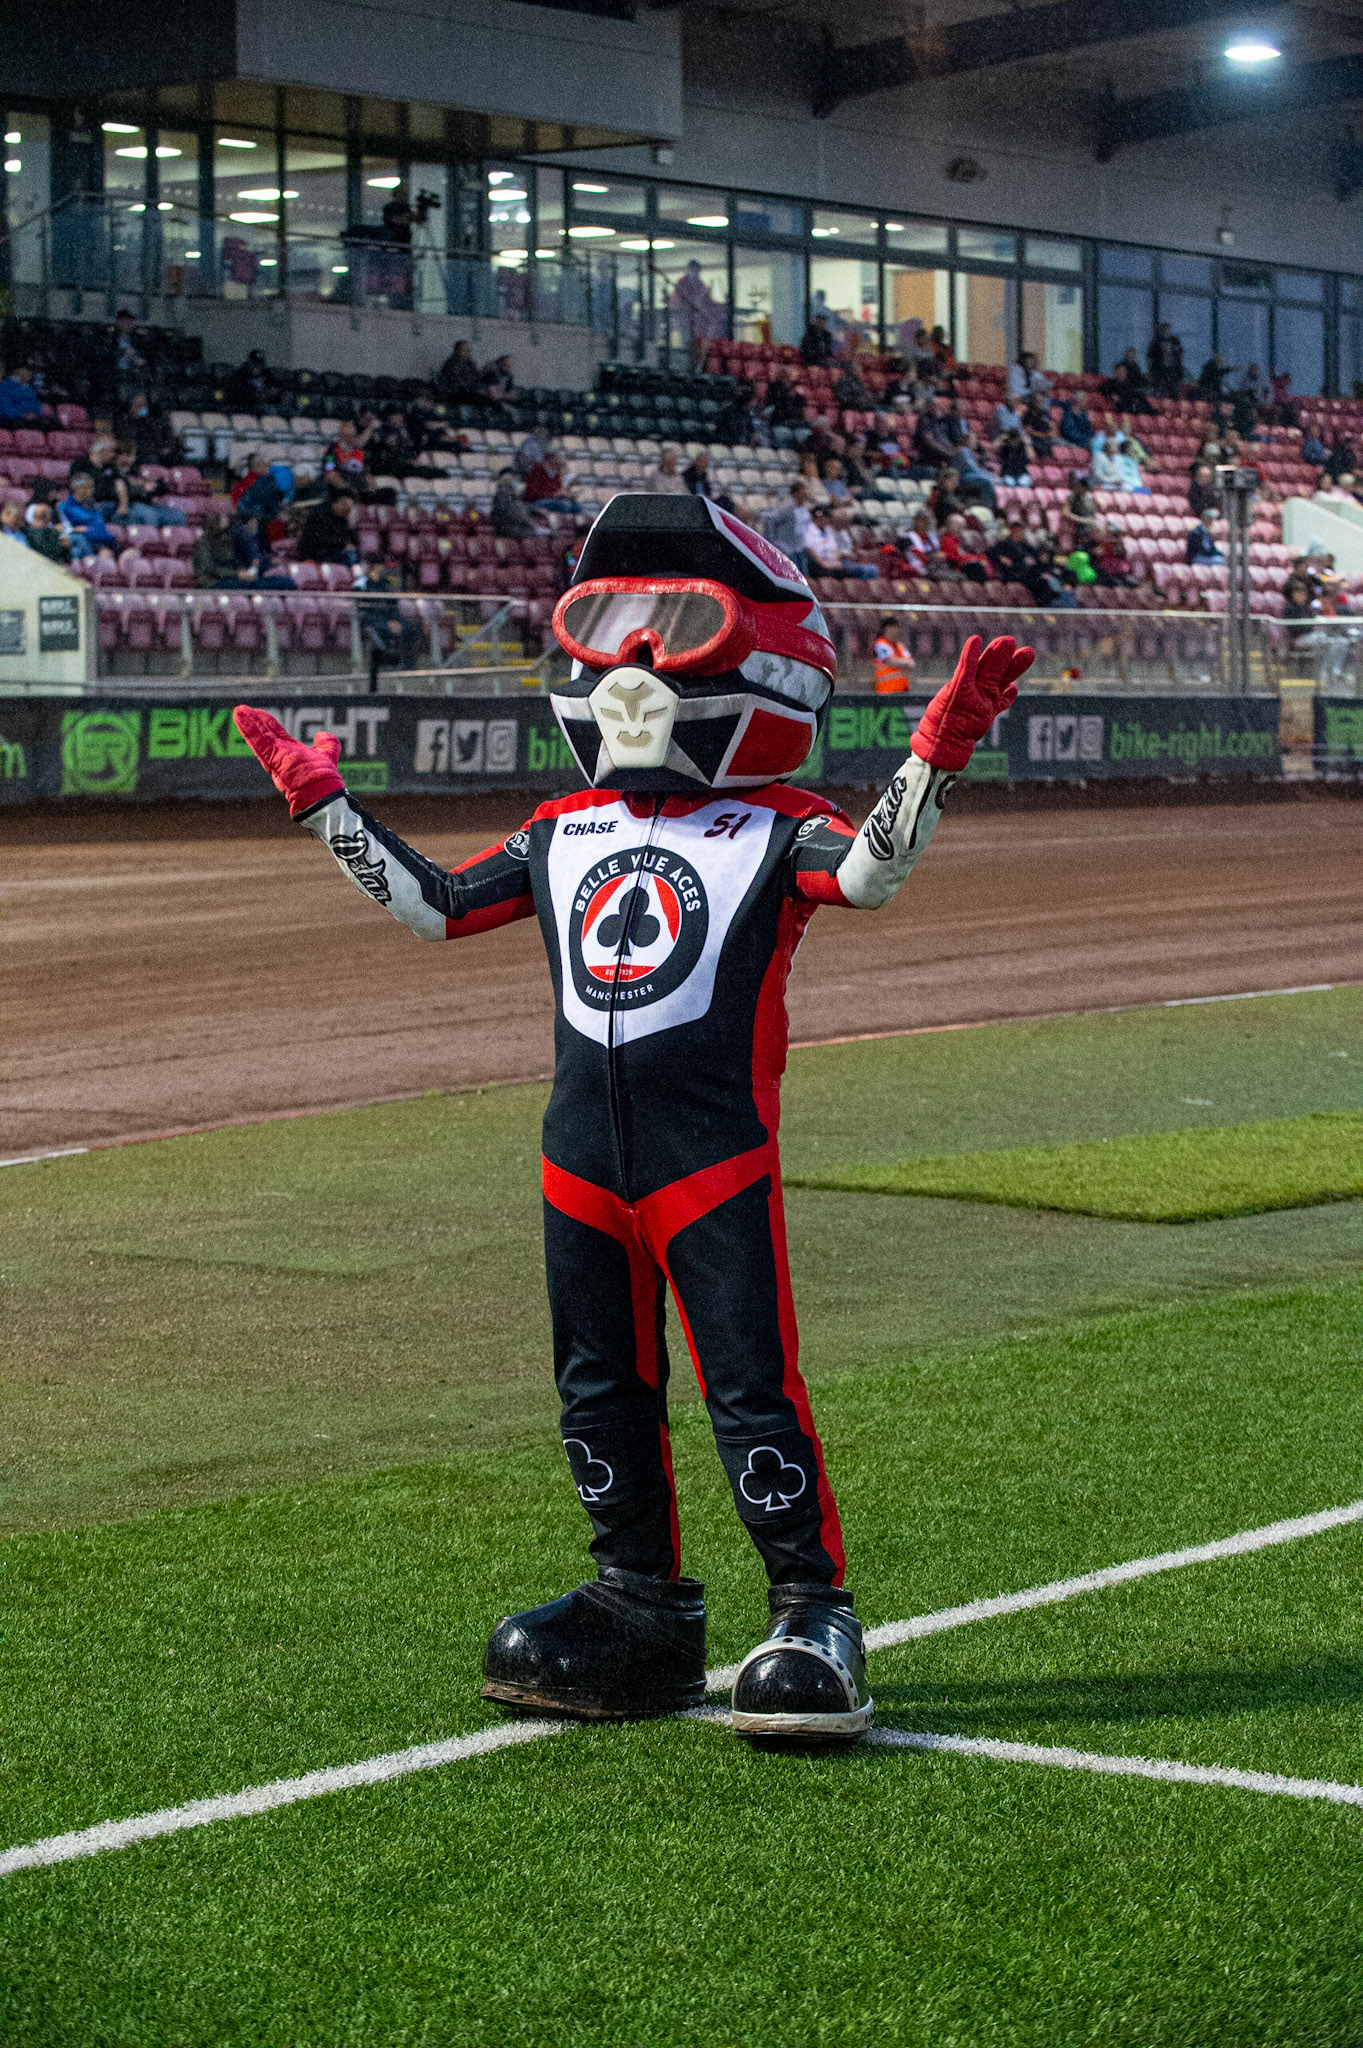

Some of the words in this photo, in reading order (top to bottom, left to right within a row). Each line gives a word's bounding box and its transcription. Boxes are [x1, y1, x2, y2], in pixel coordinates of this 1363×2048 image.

[563, 820, 619, 836] CHASE
[575, 858, 621, 912] BELLE
[631, 851, 669, 873] VUE
[668, 866, 701, 912] ACES
